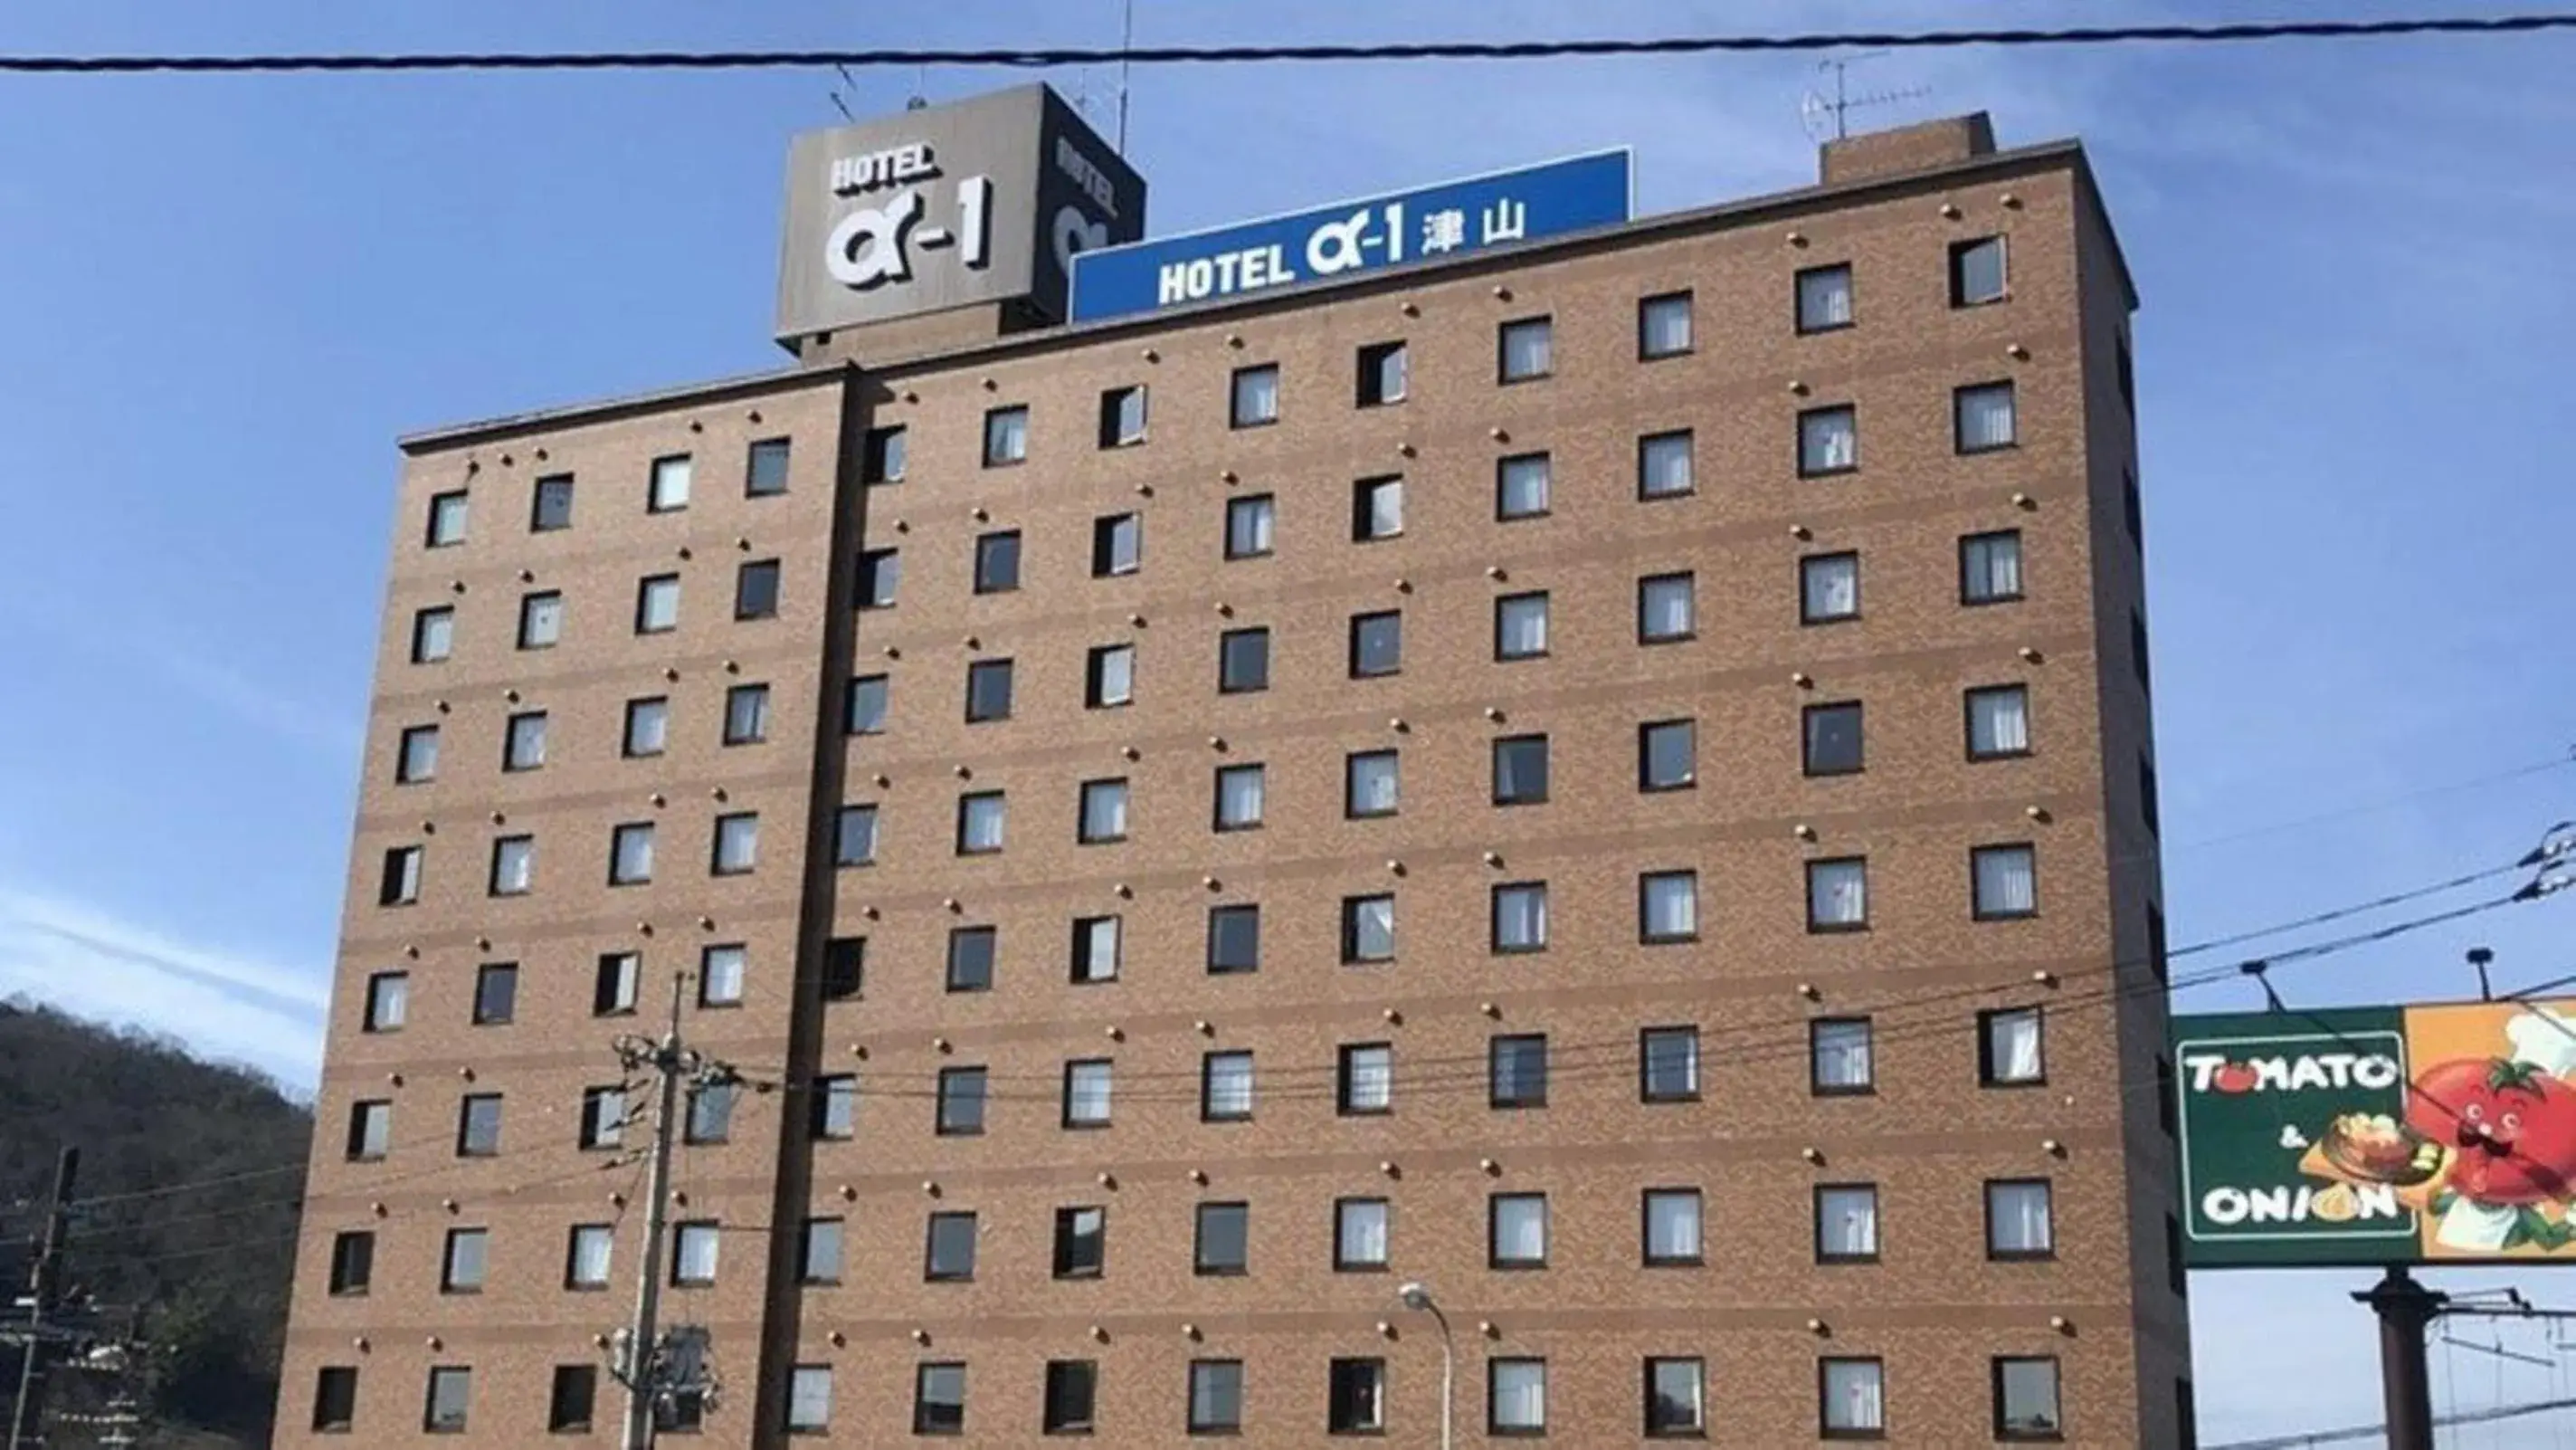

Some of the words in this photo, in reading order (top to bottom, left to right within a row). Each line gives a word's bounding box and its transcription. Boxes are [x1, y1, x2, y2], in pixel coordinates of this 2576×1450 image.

[832, 141, 936, 191] HOTEL
[1158, 245, 1294, 305] HOTEL
[1421, 198, 1526, 253] 津山
[2183, 1054, 2399, 1093] TOMATO
[2279, 1124, 2309, 1150] &
[2201, 1184, 2400, 1226] ONION
